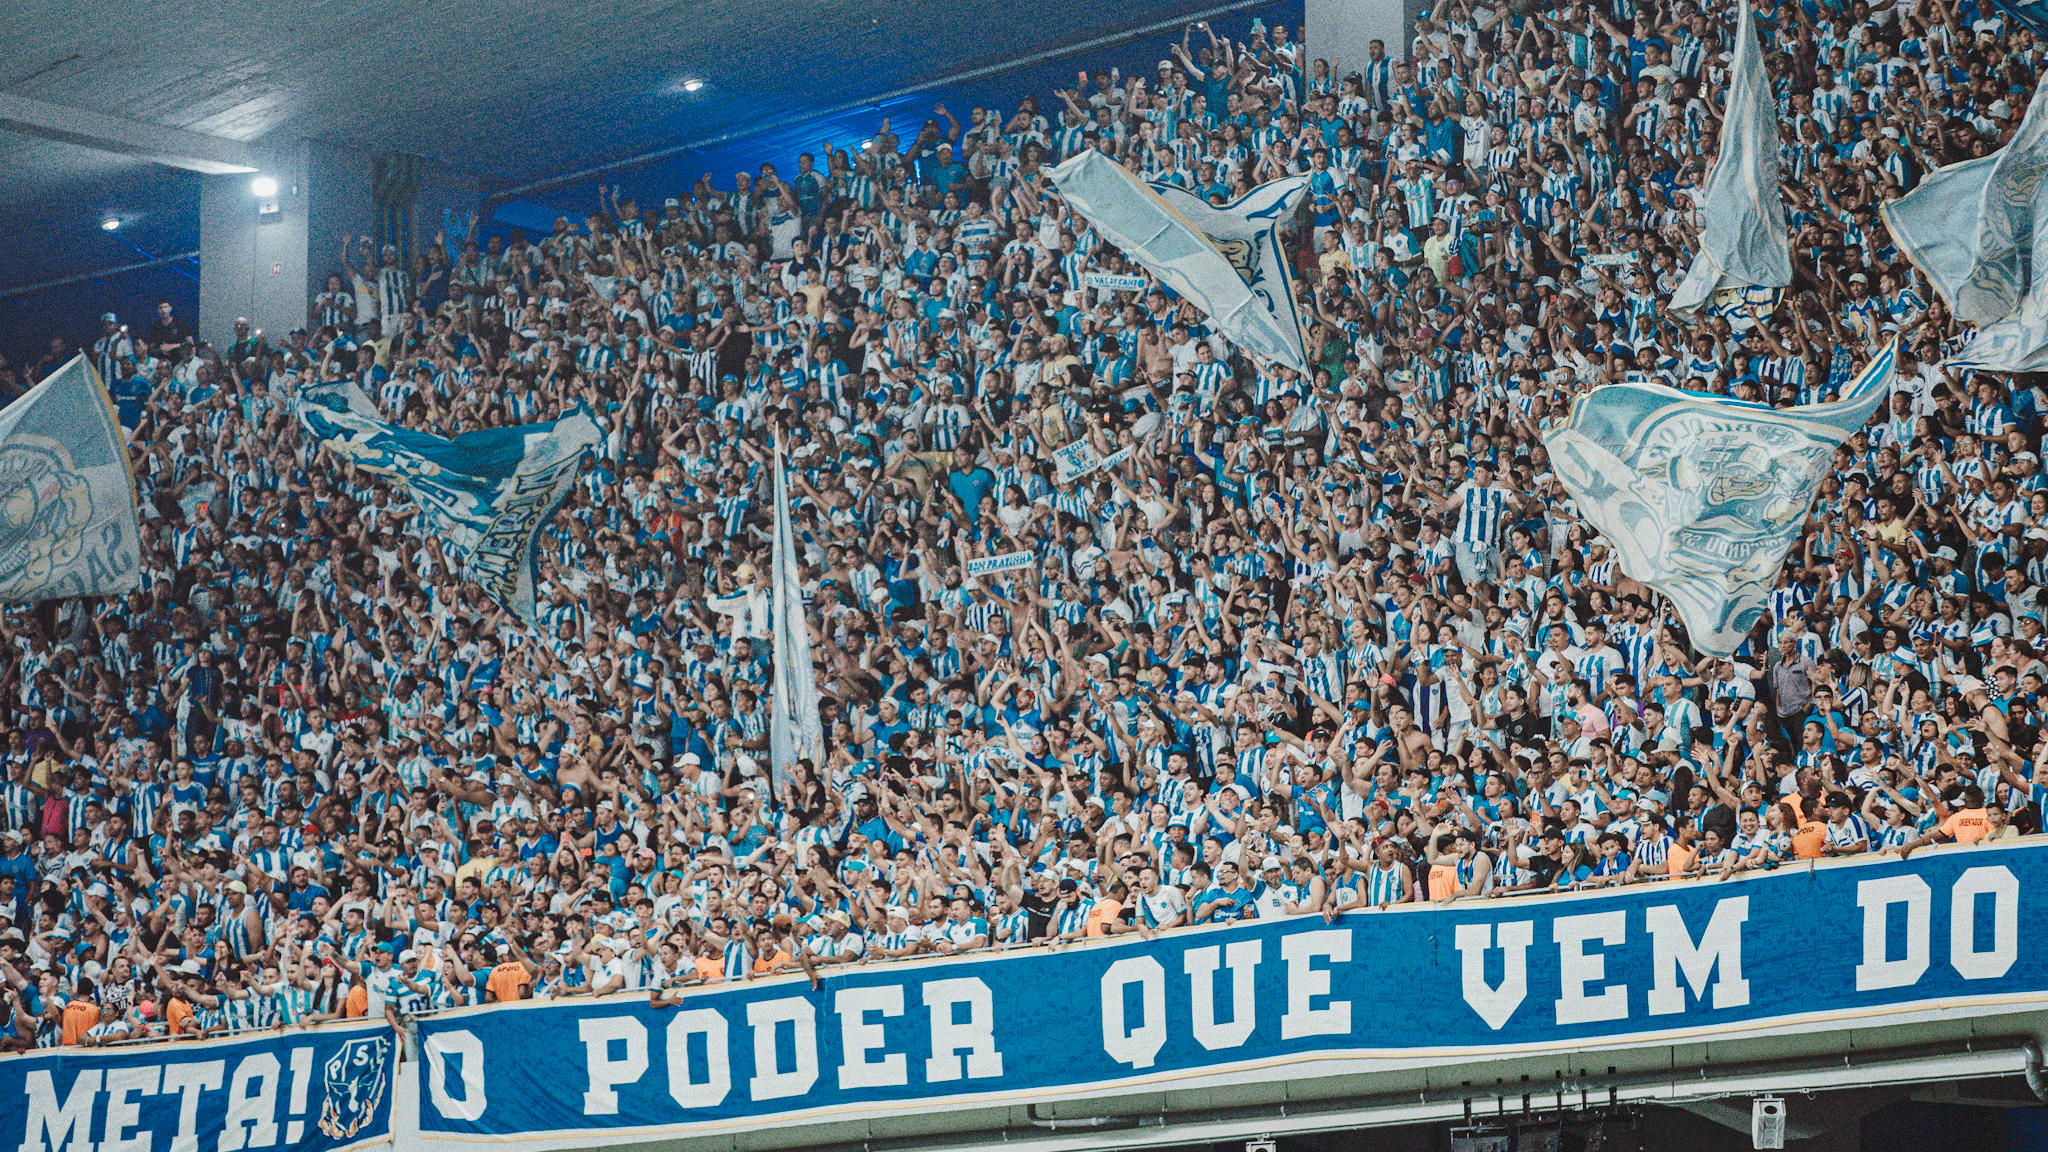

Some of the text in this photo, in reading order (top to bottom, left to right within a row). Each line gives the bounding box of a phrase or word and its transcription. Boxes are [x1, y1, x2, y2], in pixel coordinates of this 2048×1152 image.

[987, 552, 1033, 569] PRATINHA
[1959, 818, 1983, 827] ORIENTADOR
[497, 964, 520, 973] APOIO
[425, 866, 2018, 1121] O PODER QUE VEM DO
[19, 1047, 314, 1152] META!
